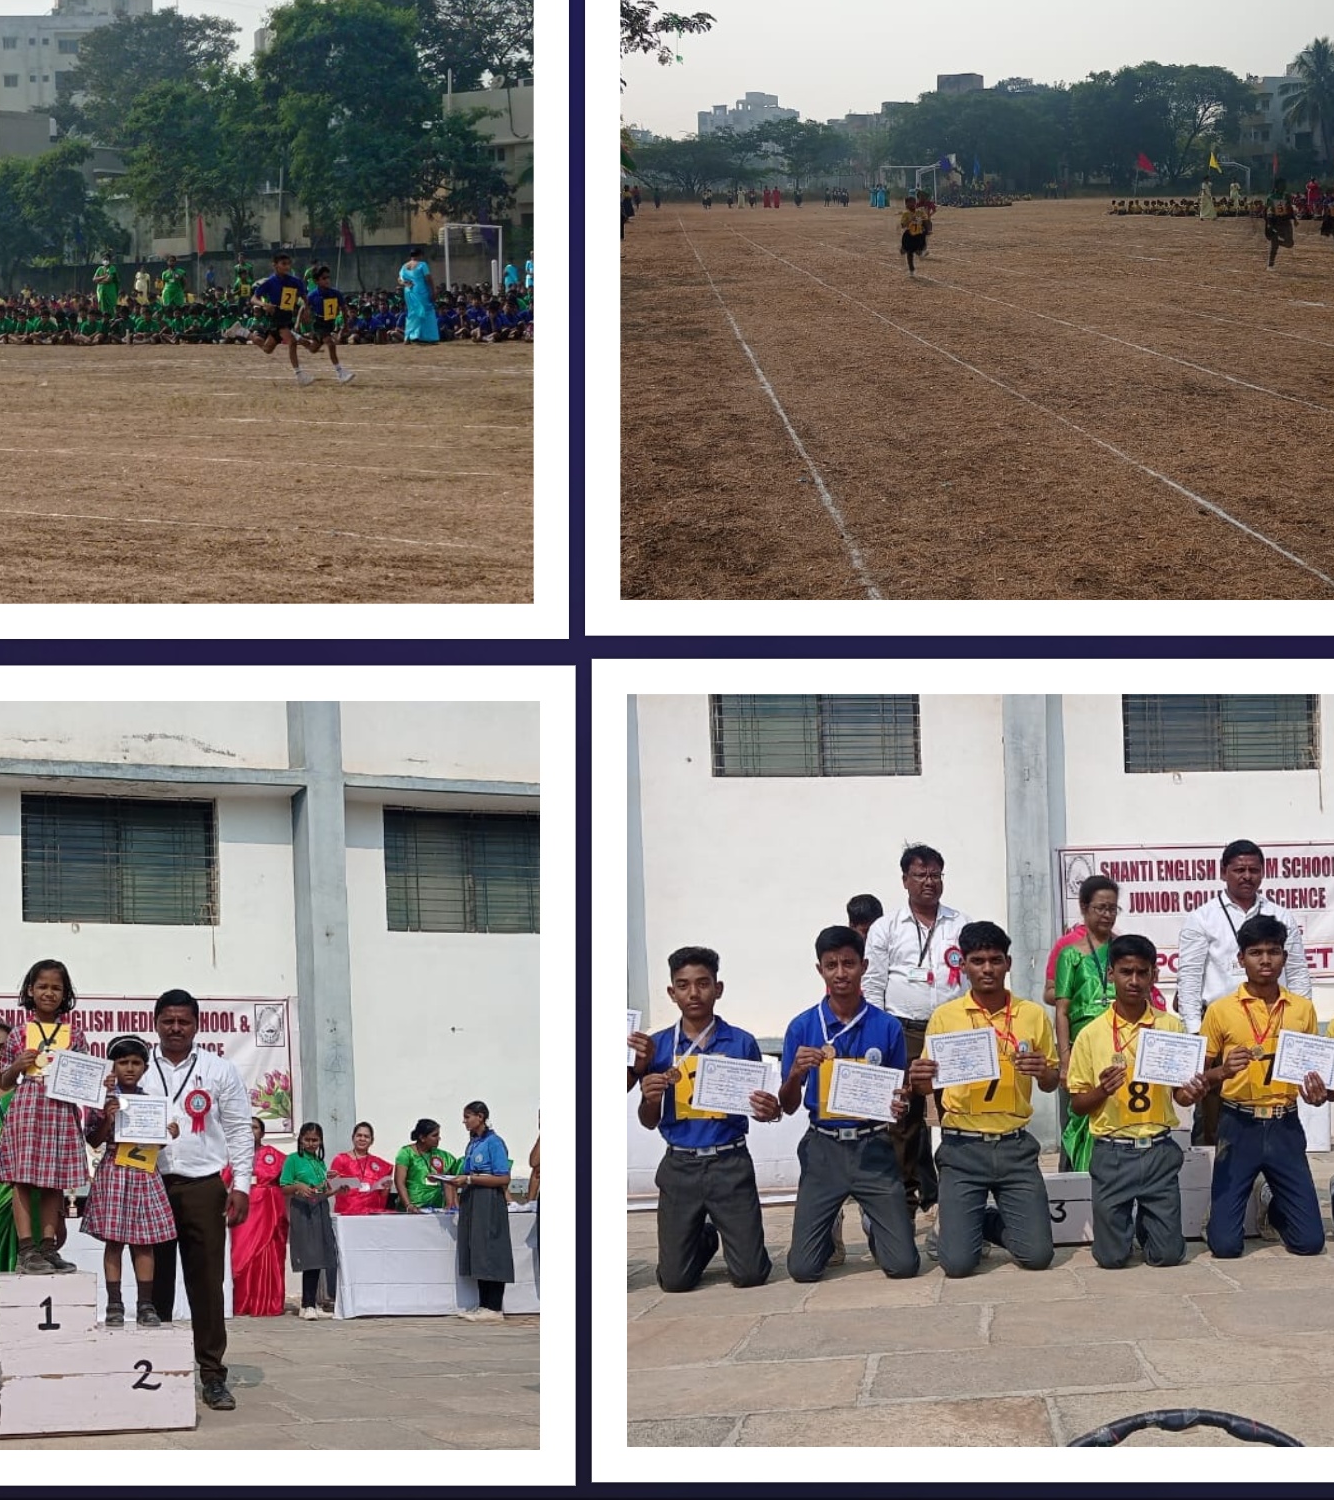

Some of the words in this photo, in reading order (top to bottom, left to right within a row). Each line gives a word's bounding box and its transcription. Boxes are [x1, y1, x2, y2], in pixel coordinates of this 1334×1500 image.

[284, 292, 292, 305] 2
[329, 304, 334, 316] 1
[1100, 861, 1153, 882] SHANTI
[1156, 859, 1215, 881] ENGLISH
[1129, 891, 1180, 914] JUNIOR
[1266, 887, 1326, 909] SCIENCE
[71, 1010, 114, 1033] GLISH
[117, 1011, 154, 1033] MEDI
[199, 1011, 237, 1033] HOOL
[240, 1015, 250, 1033] &
[1127, 1080, 1151, 1113] 8
[1051, 1200, 1067, 1223] 3
[38, 1296, 61, 1331] 1
[132, 1359, 162, 1390] 2
